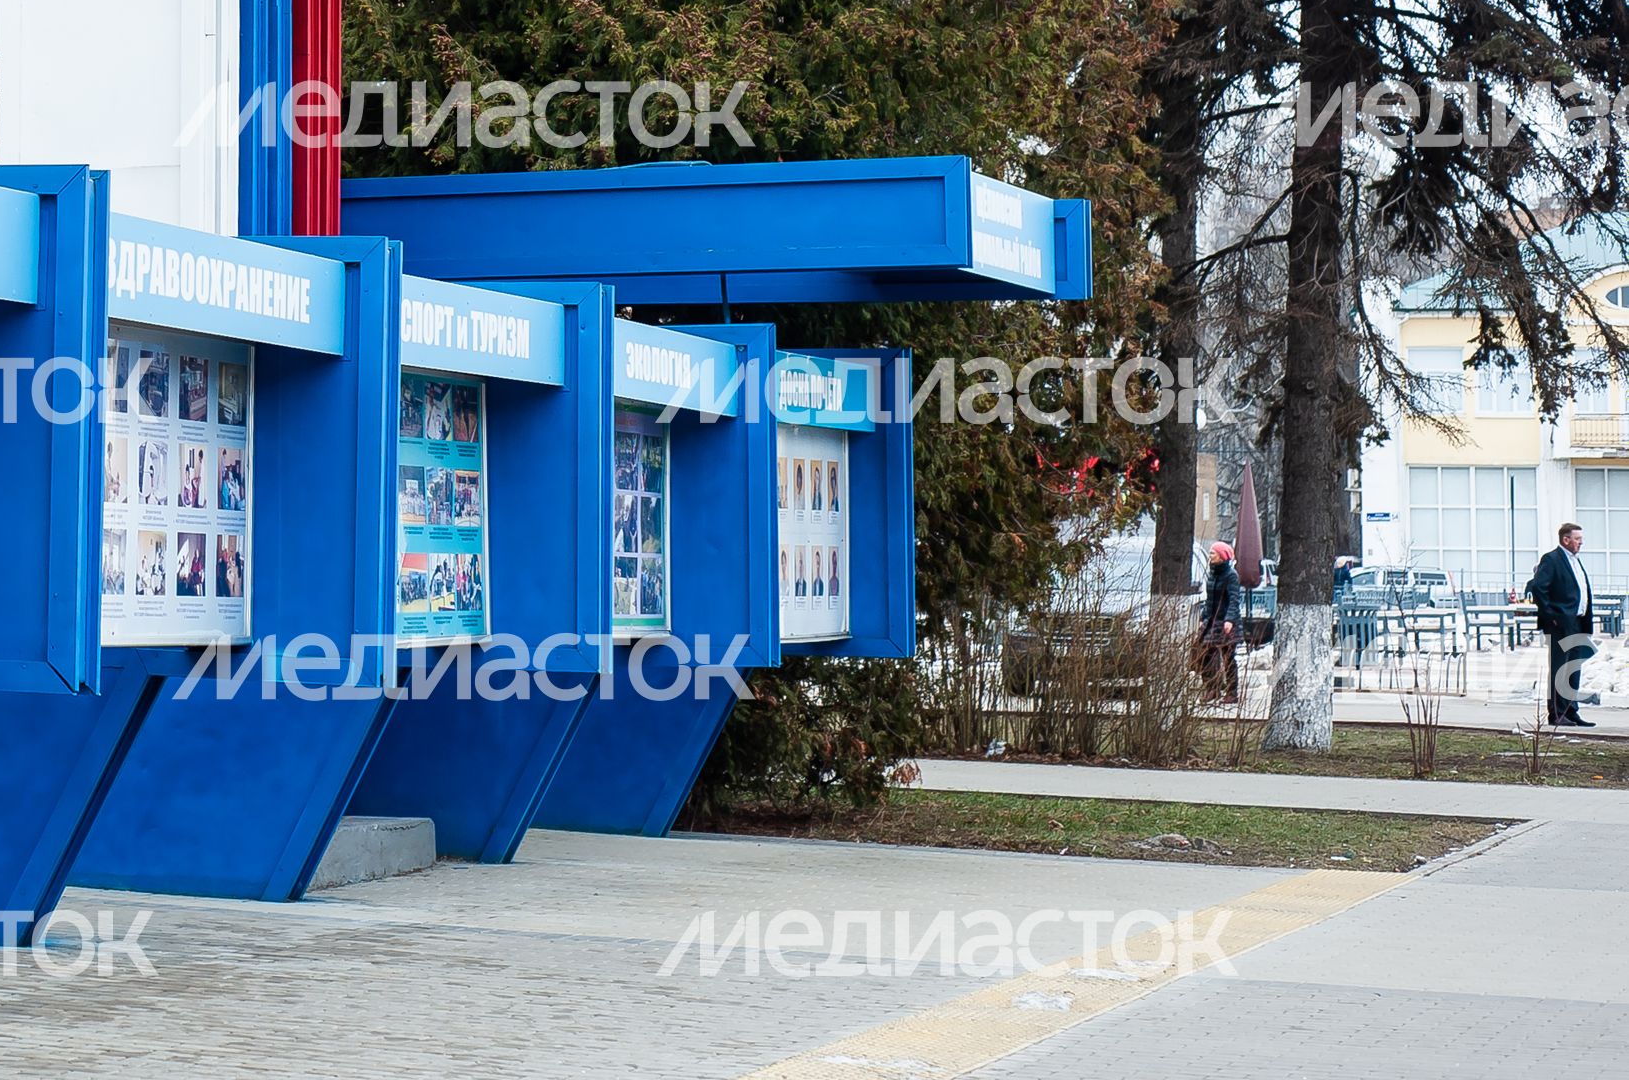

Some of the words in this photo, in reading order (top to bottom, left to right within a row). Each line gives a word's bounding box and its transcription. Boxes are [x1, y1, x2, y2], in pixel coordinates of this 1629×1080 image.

[401, 298, 455, 348] СПОРТ
[470, 310, 530, 359] ТУРИЗМ
[626, 342, 691, 389] ЭКОЛОГИЯ
